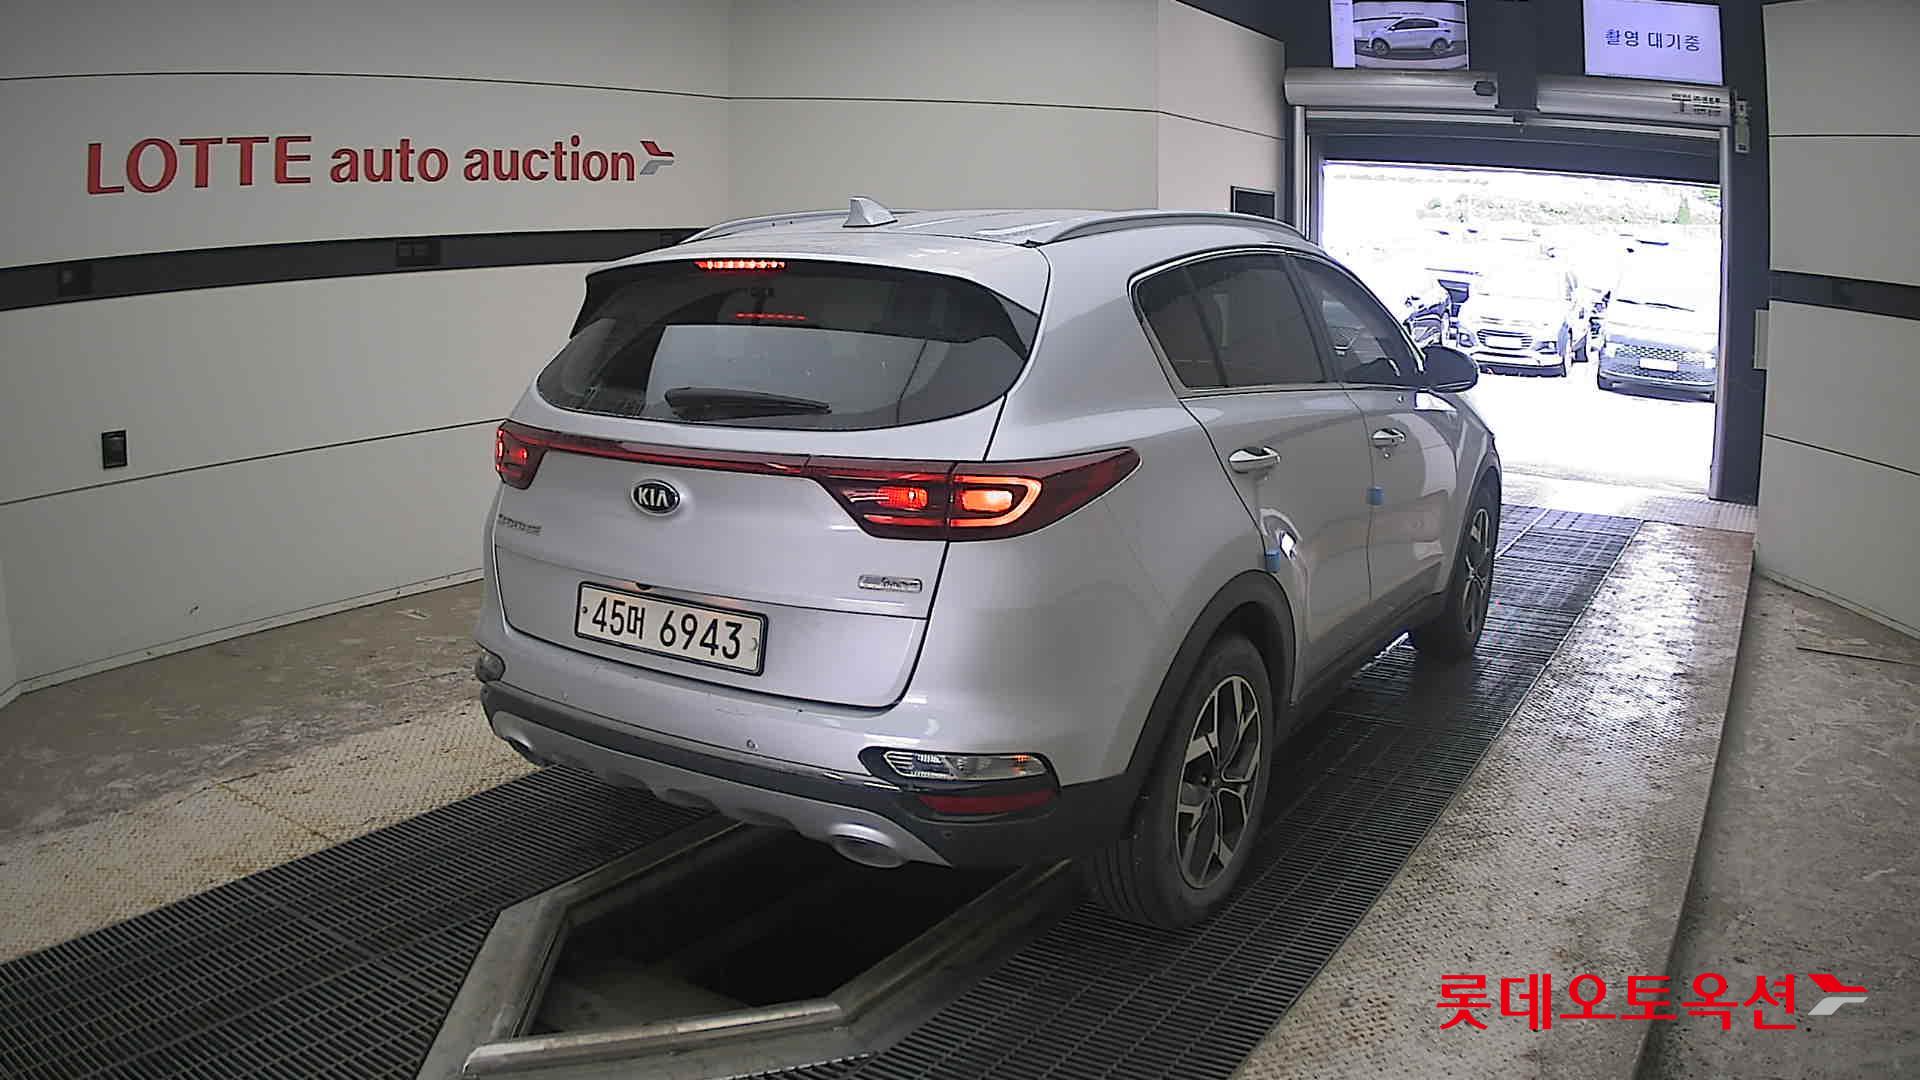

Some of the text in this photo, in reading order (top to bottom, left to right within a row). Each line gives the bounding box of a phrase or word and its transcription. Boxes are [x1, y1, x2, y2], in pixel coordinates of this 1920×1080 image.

[1604, 28, 1701, 52] 촬영 대기중
[88, 135, 635, 194] LOTTE auto auction
[638, 487, 669, 508] KIA
[591, 597, 743, 660] 45머 6943
